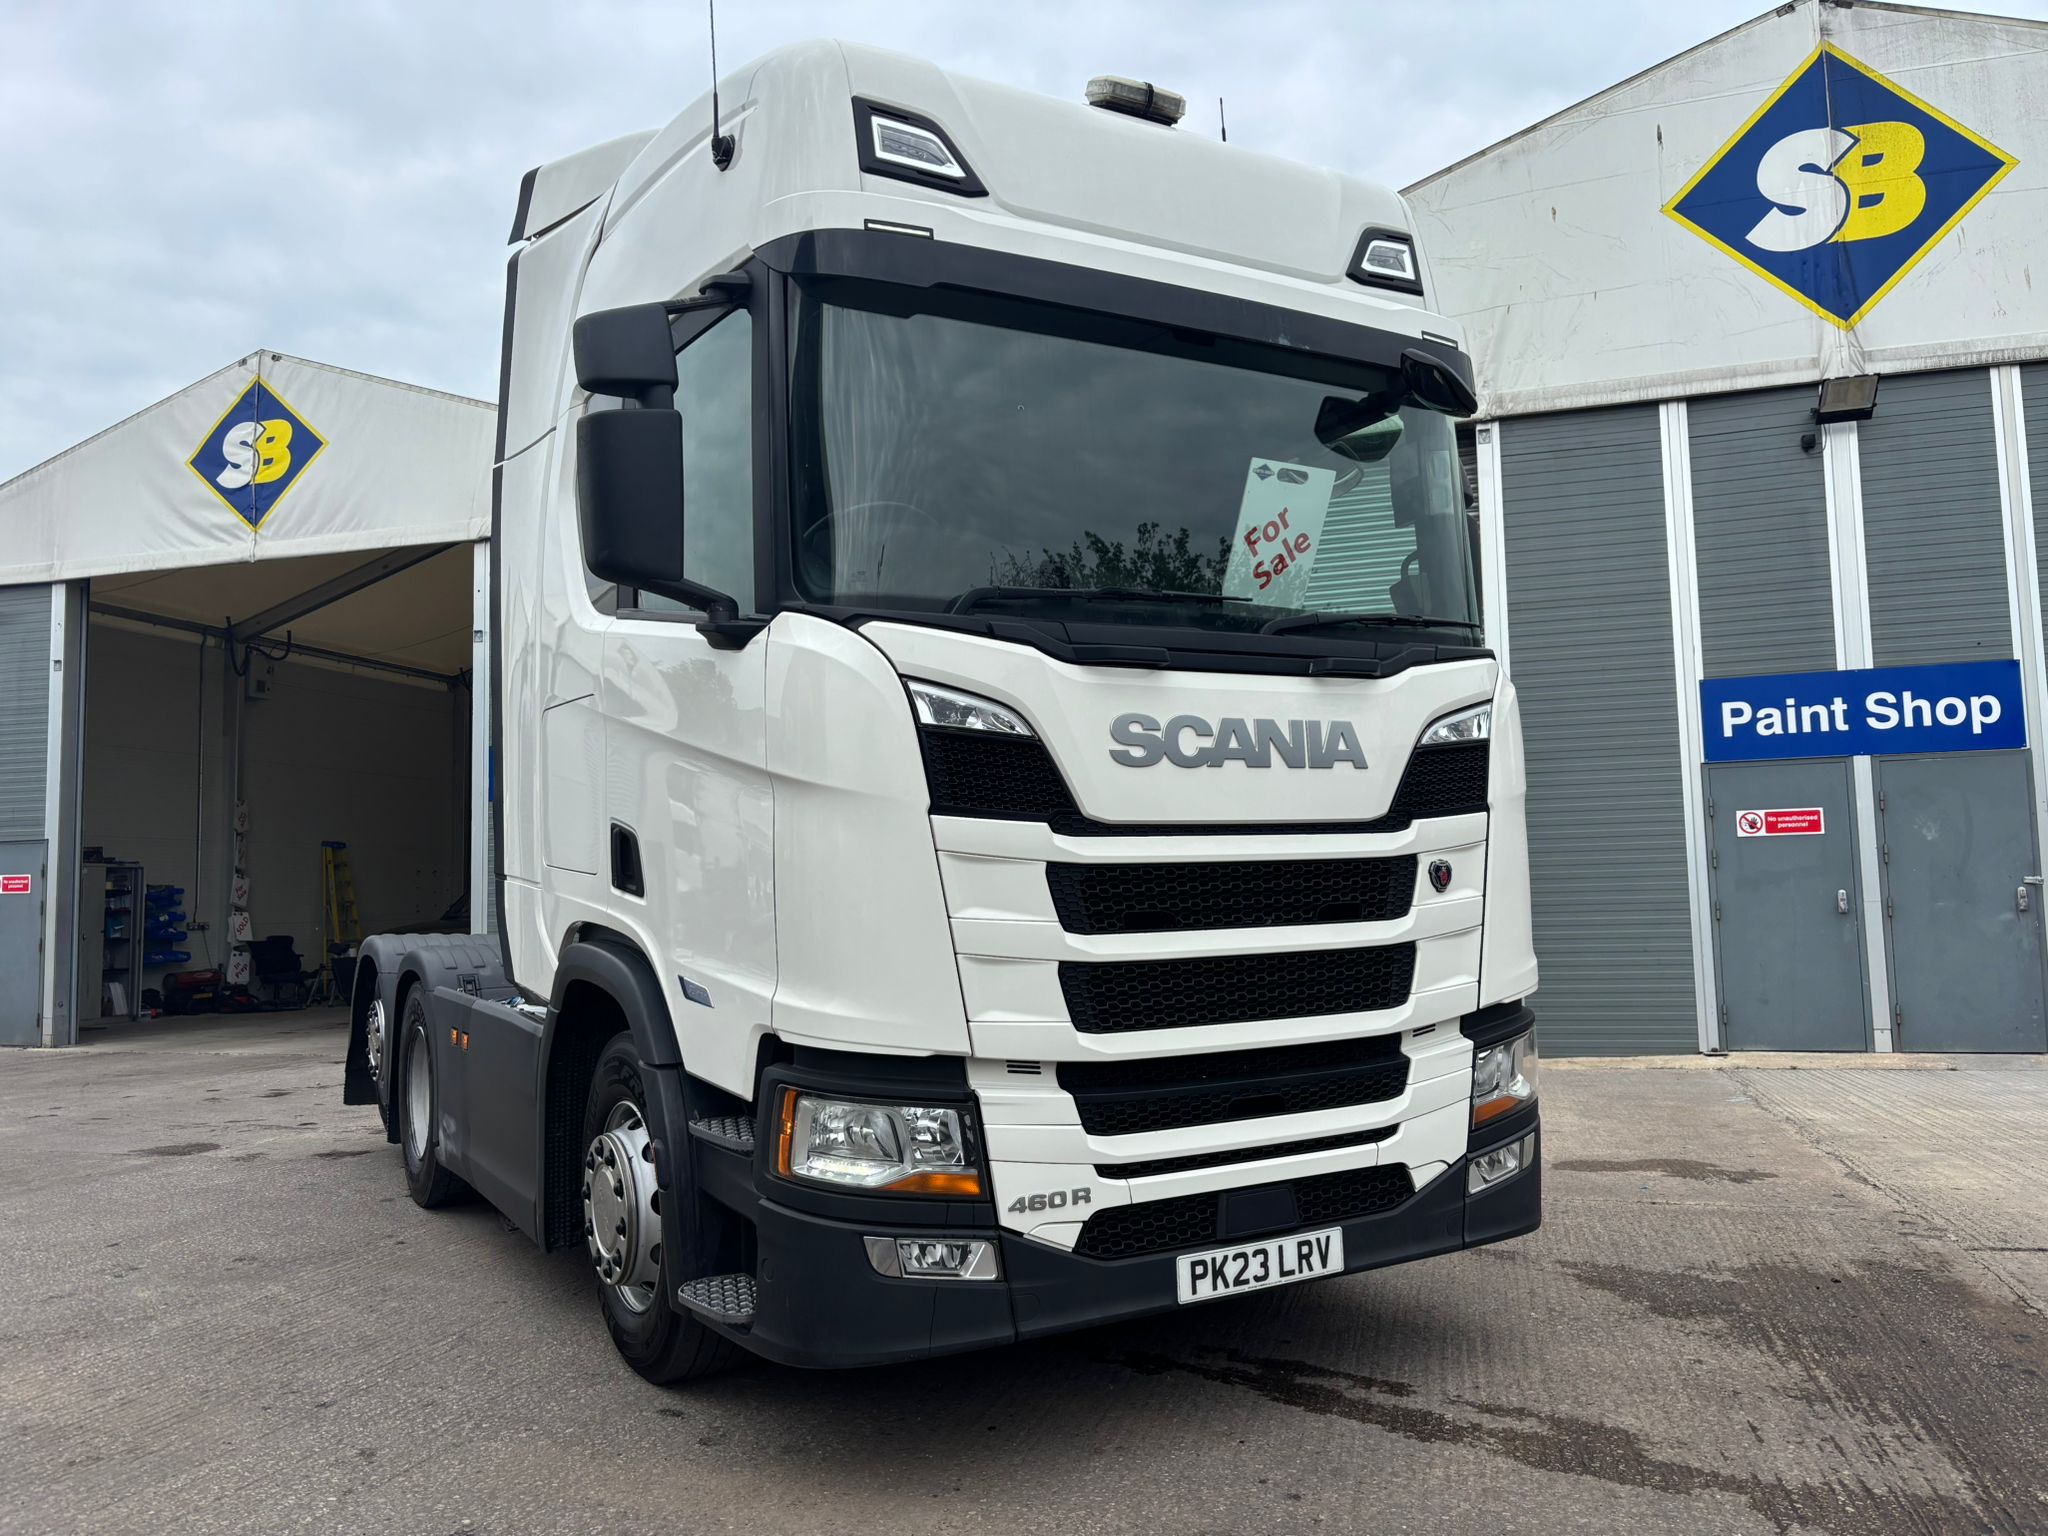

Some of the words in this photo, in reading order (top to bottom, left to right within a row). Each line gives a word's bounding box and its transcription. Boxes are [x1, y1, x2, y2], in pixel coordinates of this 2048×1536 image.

[1745, 121, 1926, 252] SB
[216, 419, 292, 488] SB
[1243, 507, 1289, 558] For
[1252, 532, 1311, 590] Sale
[1721, 696, 1849, 738] Paint
[1865, 691, 2001, 734] Shop
[1108, 712, 1369, 769] SCANIA
[1777, 814, 1818, 822] unauthorised
[1777, 821, 1809, 829] personnel
[236, 916, 249, 935] SOLD
[1008, 1191, 1067, 1213] 460
[1071, 1187, 1091, 1206] R
[1190, 1248, 1270, 1295] PK23
[1278, 1235, 1331, 1278] LRV
